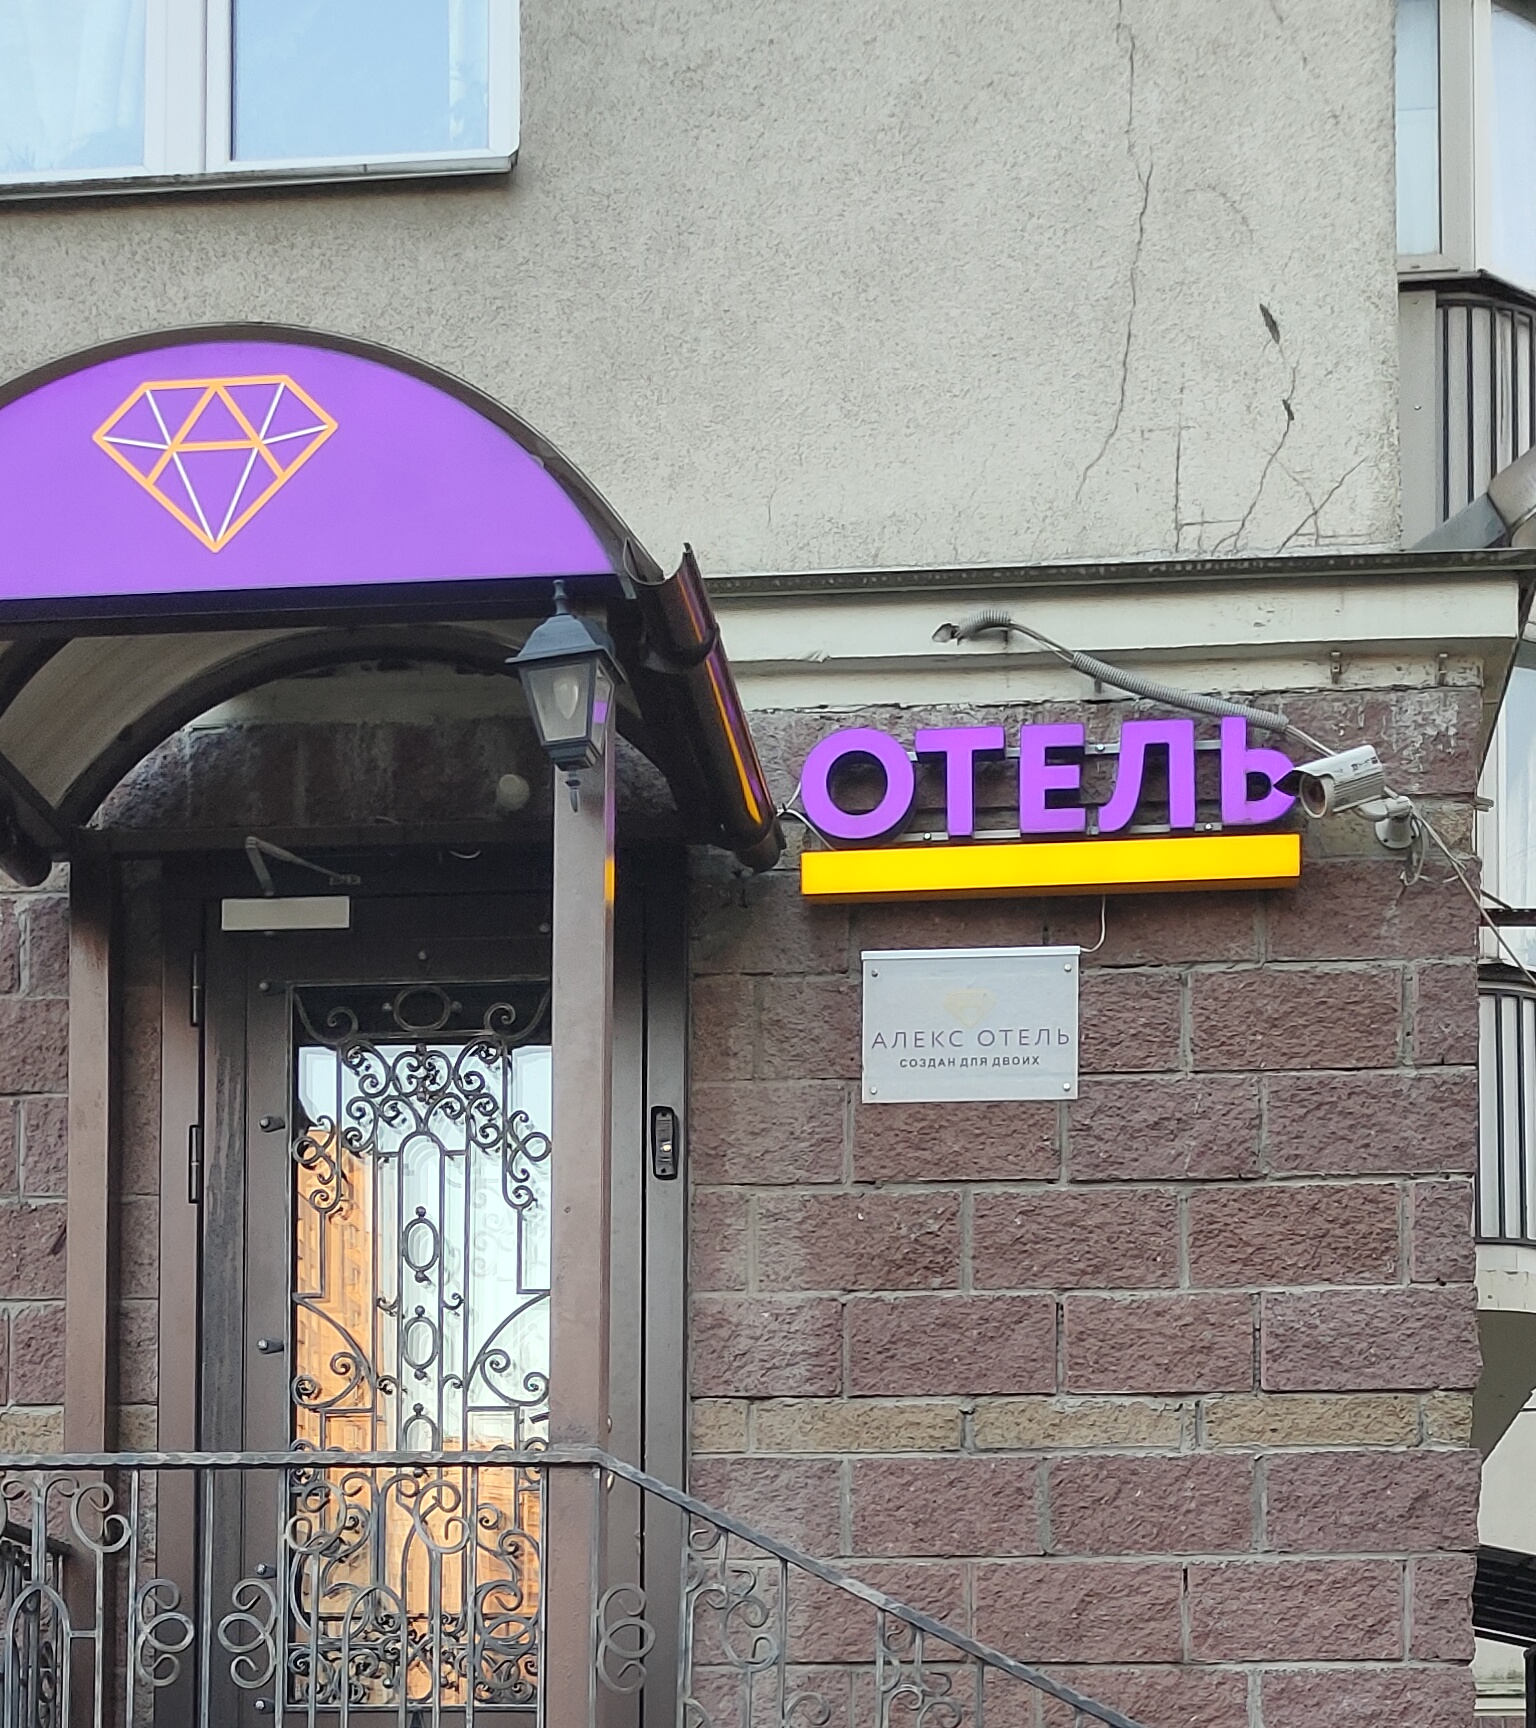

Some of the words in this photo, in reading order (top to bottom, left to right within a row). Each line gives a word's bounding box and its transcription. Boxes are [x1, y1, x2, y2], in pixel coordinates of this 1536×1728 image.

[800, 716, 1297, 839] ОТЕЛЬ
[871, 1030, 964, 1049] АЛЕКС
[977, 1028, 1070, 1047] ОТЕЛЬ
[899, 1058, 956, 1069] СОЗДАН
[959, 1057, 988, 1068] ДЛЯ
[991, 1055, 1040, 1067] ДВОИХ
